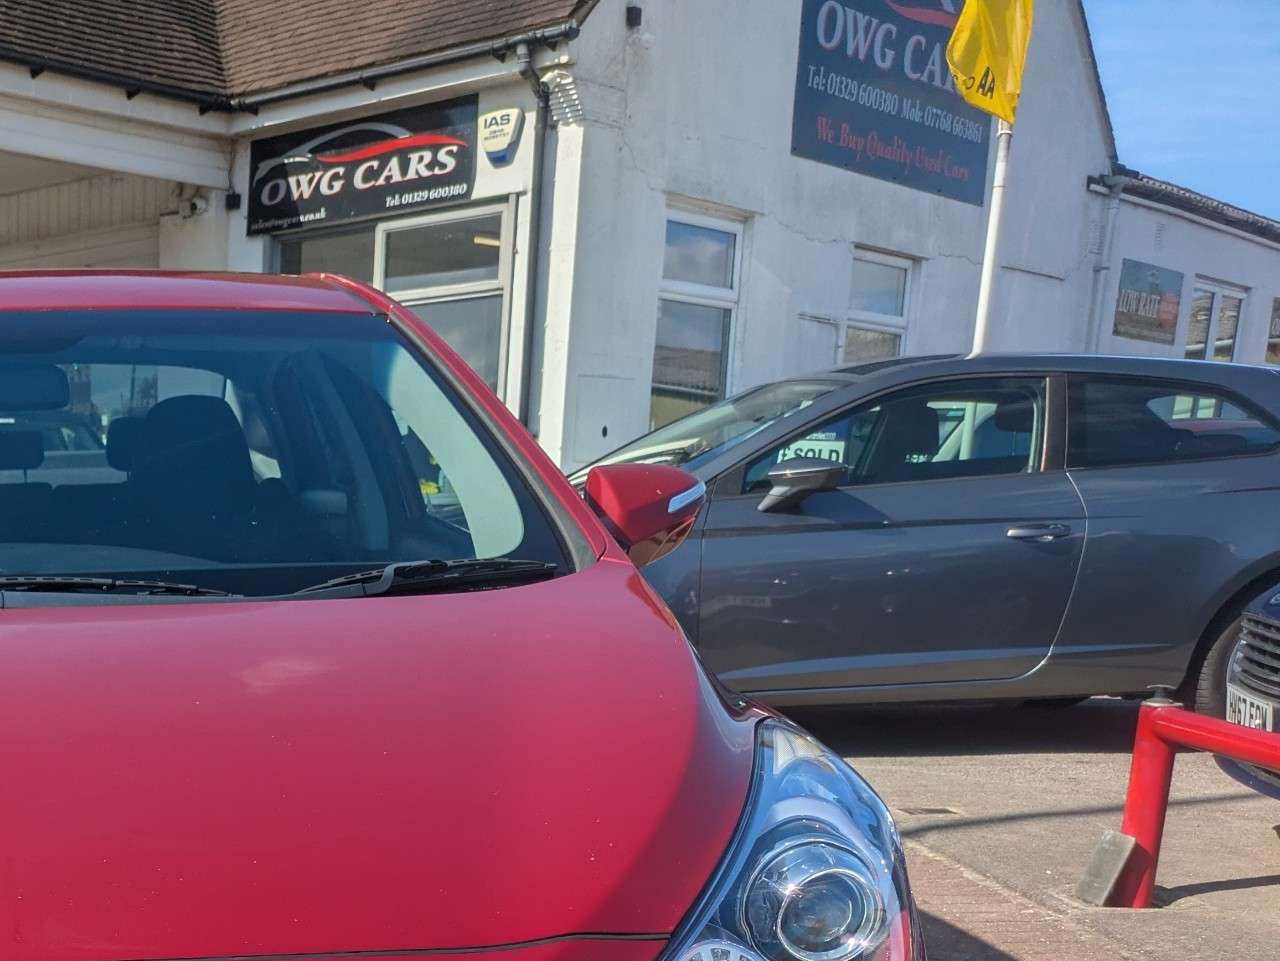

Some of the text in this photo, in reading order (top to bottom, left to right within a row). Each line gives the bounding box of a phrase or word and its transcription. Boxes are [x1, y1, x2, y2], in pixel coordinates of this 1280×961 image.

[816, 0, 955, 92] OWG CA
[807, 65, 826, 91] Tel:
[827, 72, 858, 103] 01329
[858, 83, 899, 116] 600380
[901, 98, 923, 123] Mob:
[483, 113, 511, 129] IAS
[816, 115, 834, 145] We
[839, 122, 865, 162] Buy
[261, 145, 459, 206] OWG CARS
[401, 190, 429, 205] 01329
[429, 183, 468, 200] 600380
[793, 448, 840, 463] SOLD
